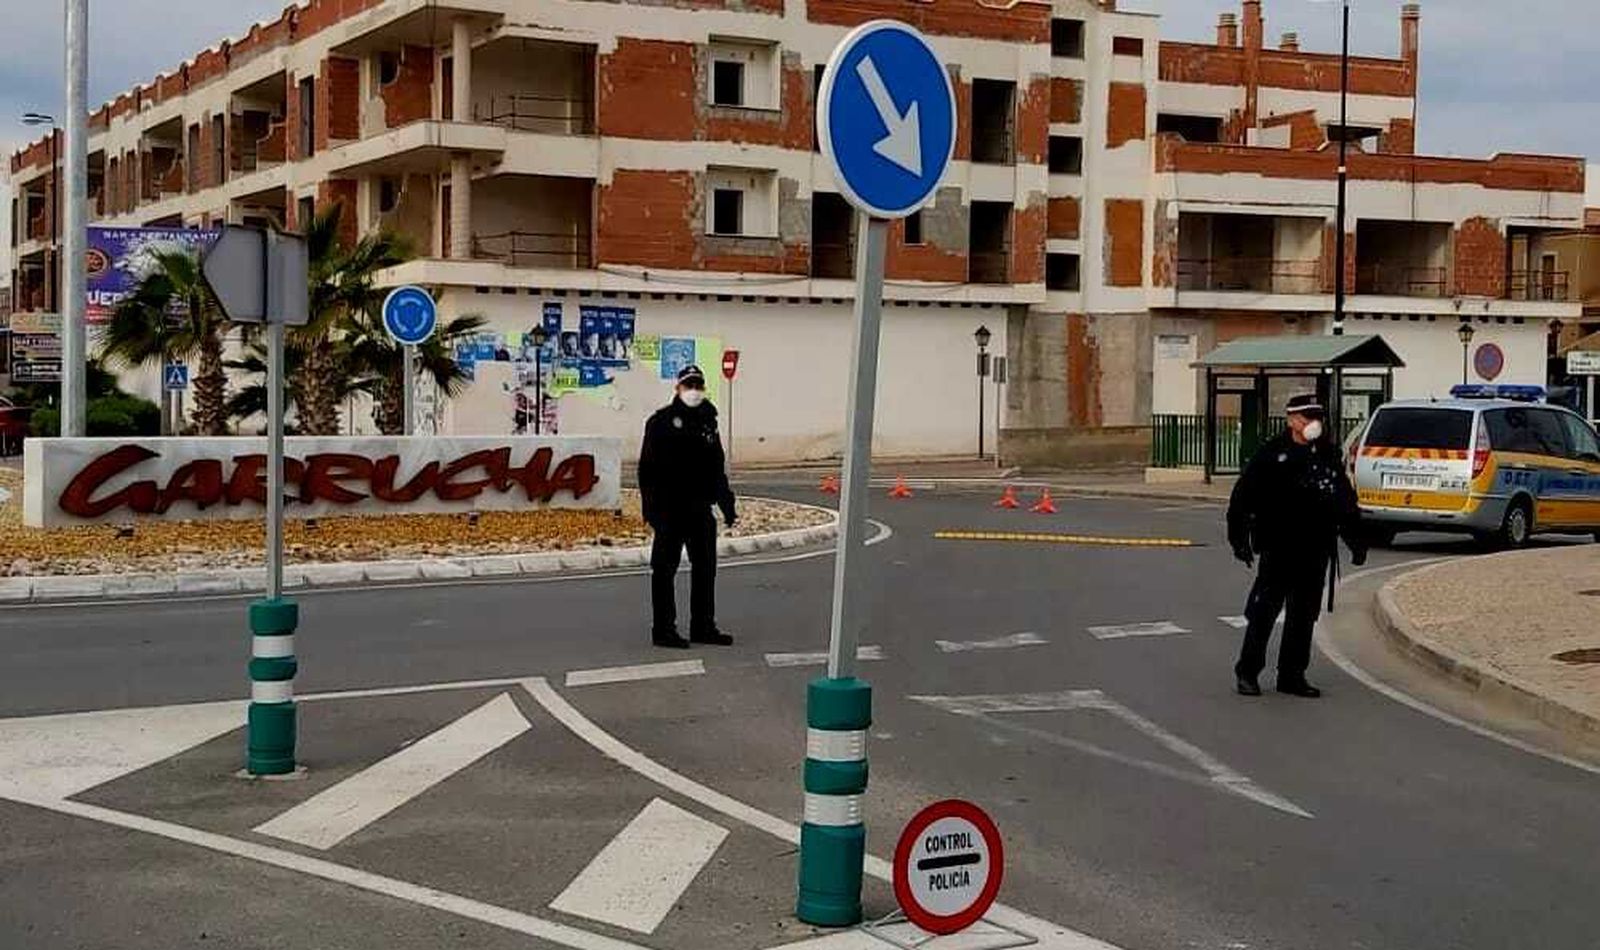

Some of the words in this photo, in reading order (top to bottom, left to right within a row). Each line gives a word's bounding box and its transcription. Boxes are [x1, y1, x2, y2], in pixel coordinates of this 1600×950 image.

[60, 445, 600, 518] GARRUCHA
[925, 832, 973, 853] CONTROL
[929, 866, 970, 891] POLICÍA
